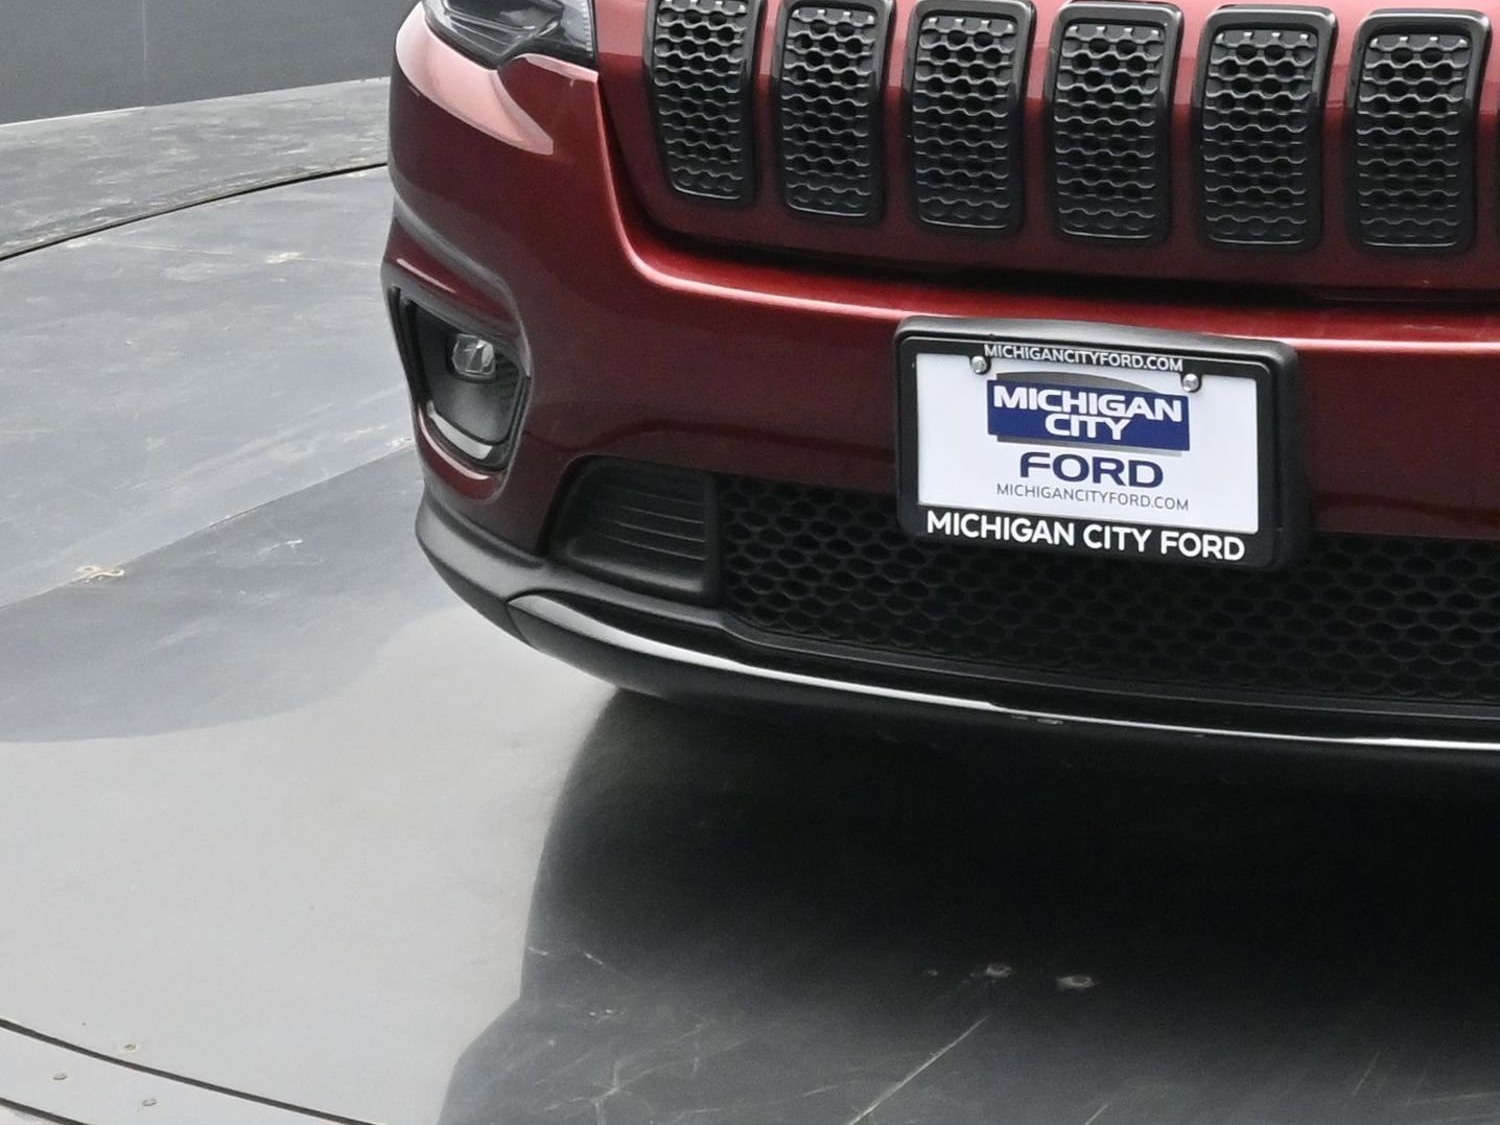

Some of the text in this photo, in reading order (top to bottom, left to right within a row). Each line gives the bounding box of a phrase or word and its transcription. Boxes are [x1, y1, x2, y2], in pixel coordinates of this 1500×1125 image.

[984, 343, 1183, 373] MICHIGANCITYFORD.COM
[993, 385, 1182, 423] MICHIGAN
[1045, 413, 1130, 440] CITY
[1020, 451, 1164, 488] FORD
[996, 483, 1189, 512] MICHIGANCITYFORD.COM
[927, 510, 1245, 562] MICHIGAN CITY FORD
